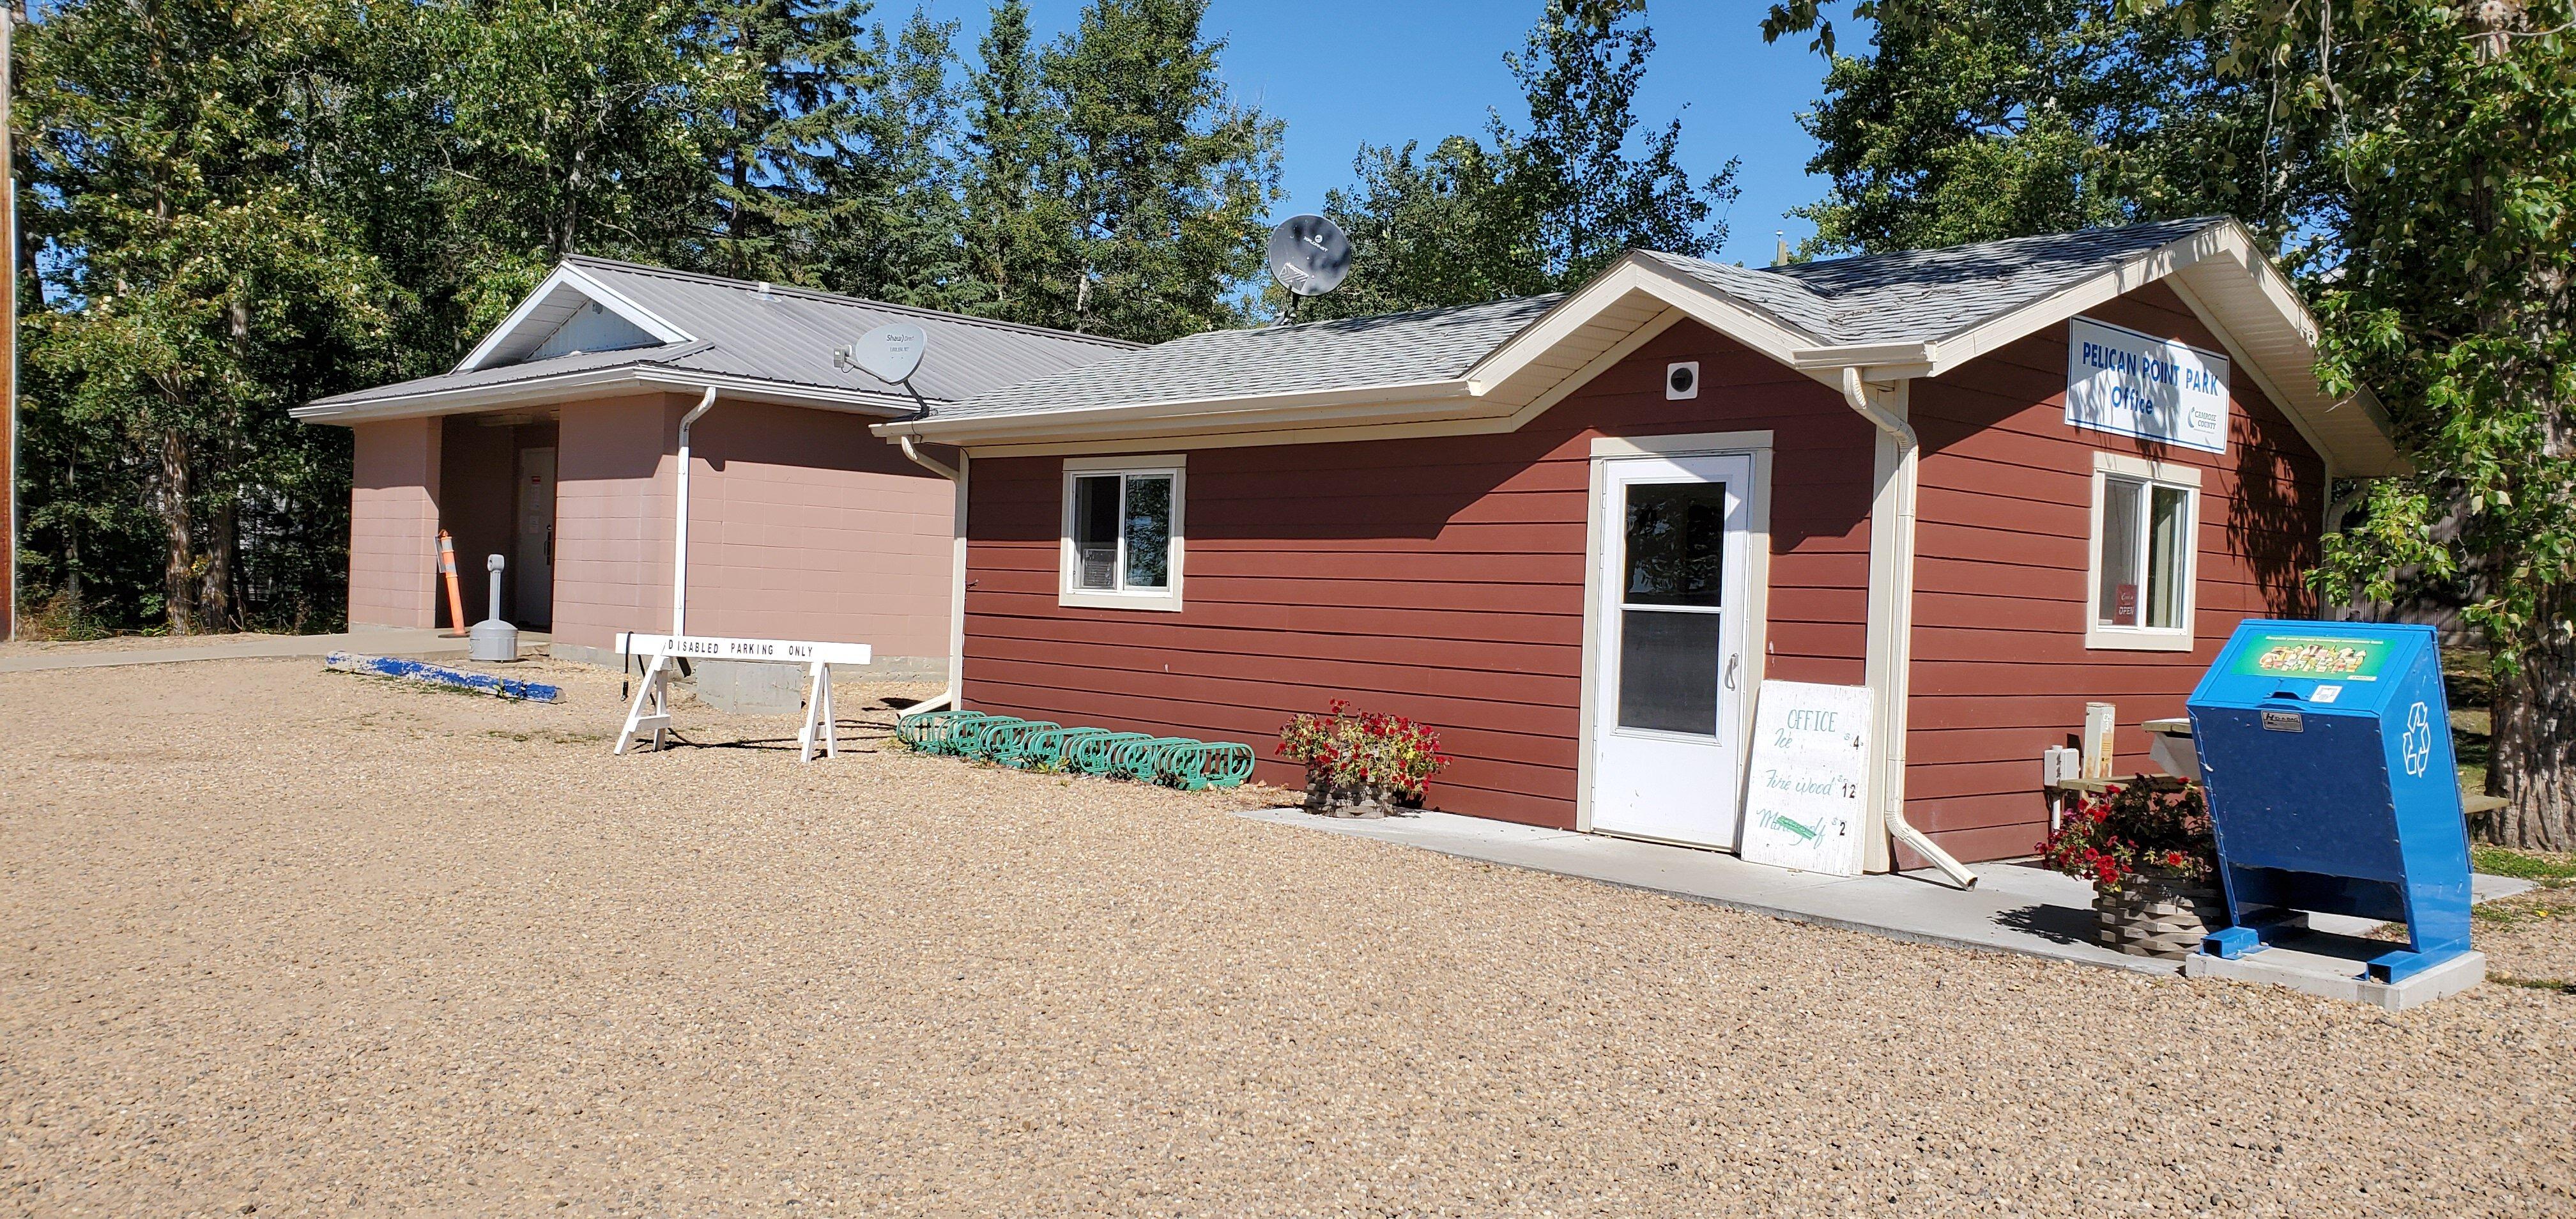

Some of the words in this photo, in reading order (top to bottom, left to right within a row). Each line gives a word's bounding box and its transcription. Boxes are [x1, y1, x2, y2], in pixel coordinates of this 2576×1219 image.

[2083, 342, 2136, 376] PELICAN
[2142, 356, 2180, 387] POINT
[2186, 367, 2218, 396] PARK
[2112, 386, 2153, 415] Office
[2119, 606, 2134, 615] OPEN
[668, 639, 719, 654] DISABLED
[731, 643, 773, 655] PARKING
[788, 645, 813, 657] ONLY
[1788, 709, 1838, 732] OFFICE
[1774, 728, 1793, 748] Ice
